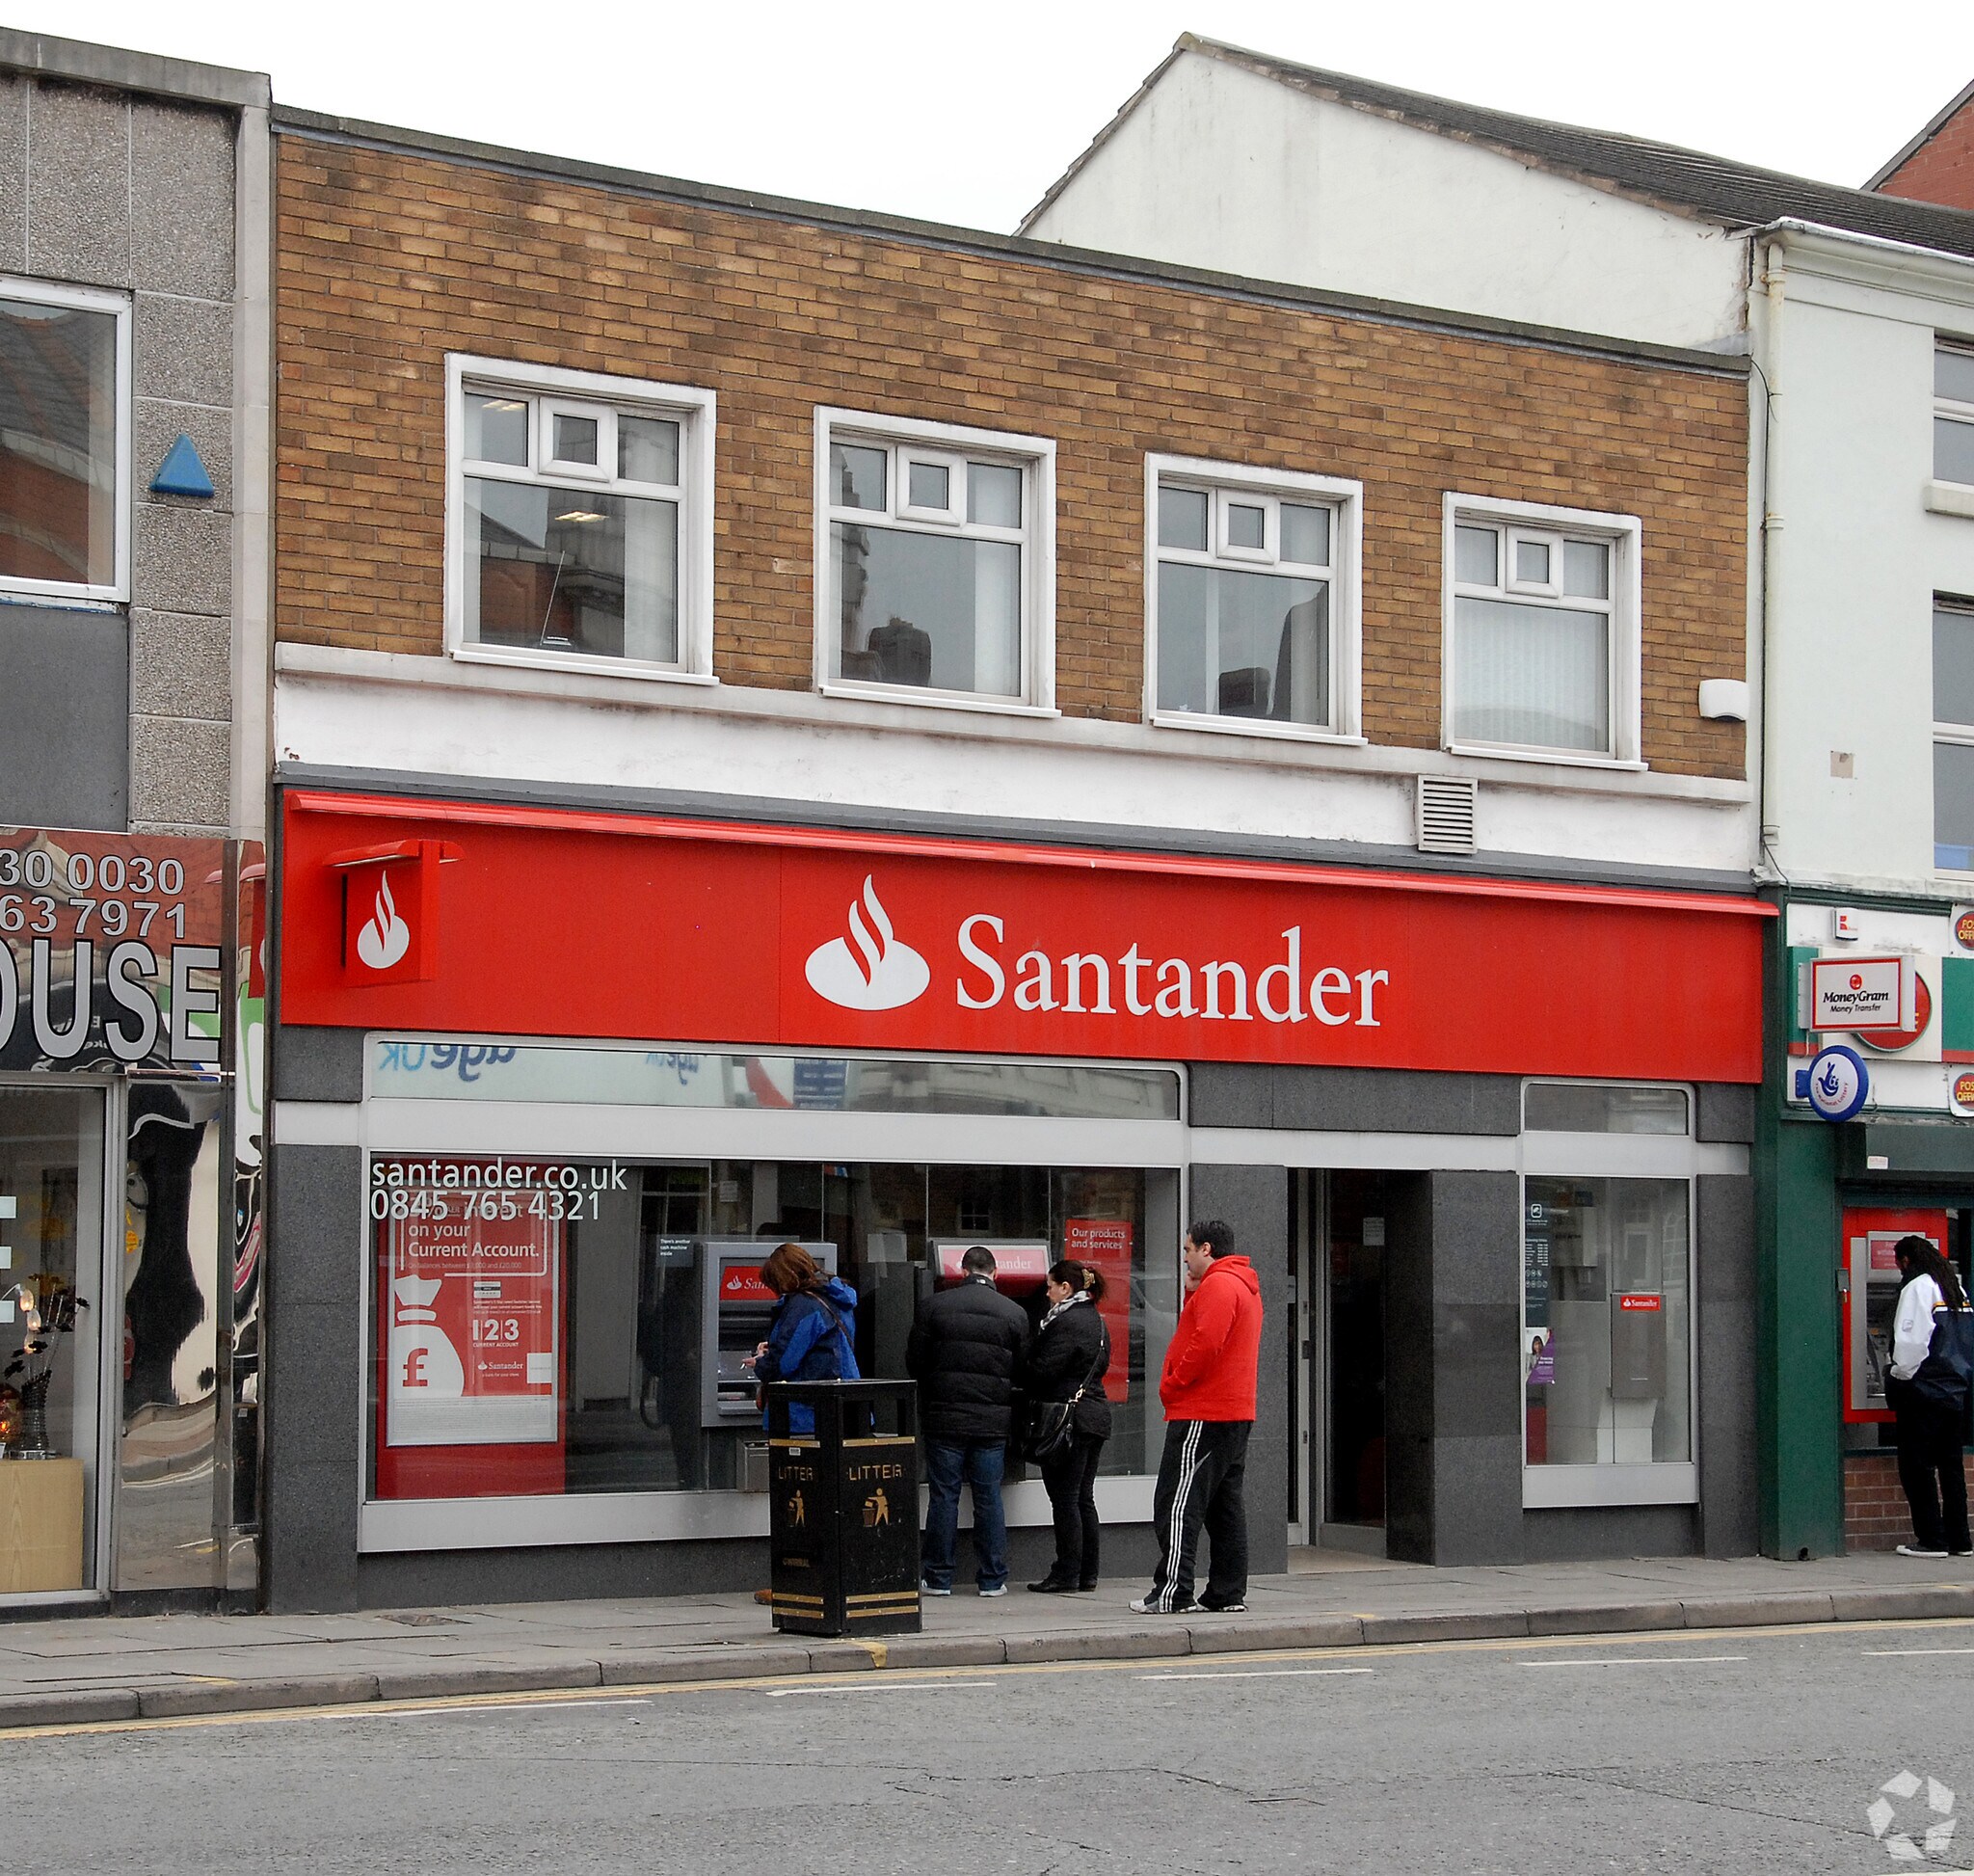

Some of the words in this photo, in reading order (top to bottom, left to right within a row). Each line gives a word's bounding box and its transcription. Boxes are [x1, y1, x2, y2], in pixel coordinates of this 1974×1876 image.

[67, 852, 185, 896] 0030
[0, 894, 58, 934] 63
[68, 898, 185, 939] 7971
[1962, 919, 1974, 929] PO
[956, 912, 1389, 1027] Santander
[1823, 990, 1889, 1005] MoneyGram
[1830, 1005, 1853, 1014] Money
[1854, 1004, 1881, 1012] Transfer
[372, 1157, 627, 1191] santander.co.uk
[370, 1190, 448, 1220] 0845
[461, 1191, 517, 1220] 765
[527, 1191, 600, 1220] 4321
[409, 1225, 429, 1237] on
[433, 1225, 470, 1241] your
[1072, 1228, 1088, 1237] Our
[1090, 1228, 1126, 1240] products
[409, 1242, 467, 1257] Current
[471, 1242, 540, 1257] Account.
[1072, 1239, 1087, 1248] and
[1089, 1240, 1122, 1249] services
[744, 1277, 768, 1290] San
[489, 1360, 523, 1370] Santander
[778, 1466, 814, 1481] LITTER
[848, 1464, 902, 1480] LITTER
